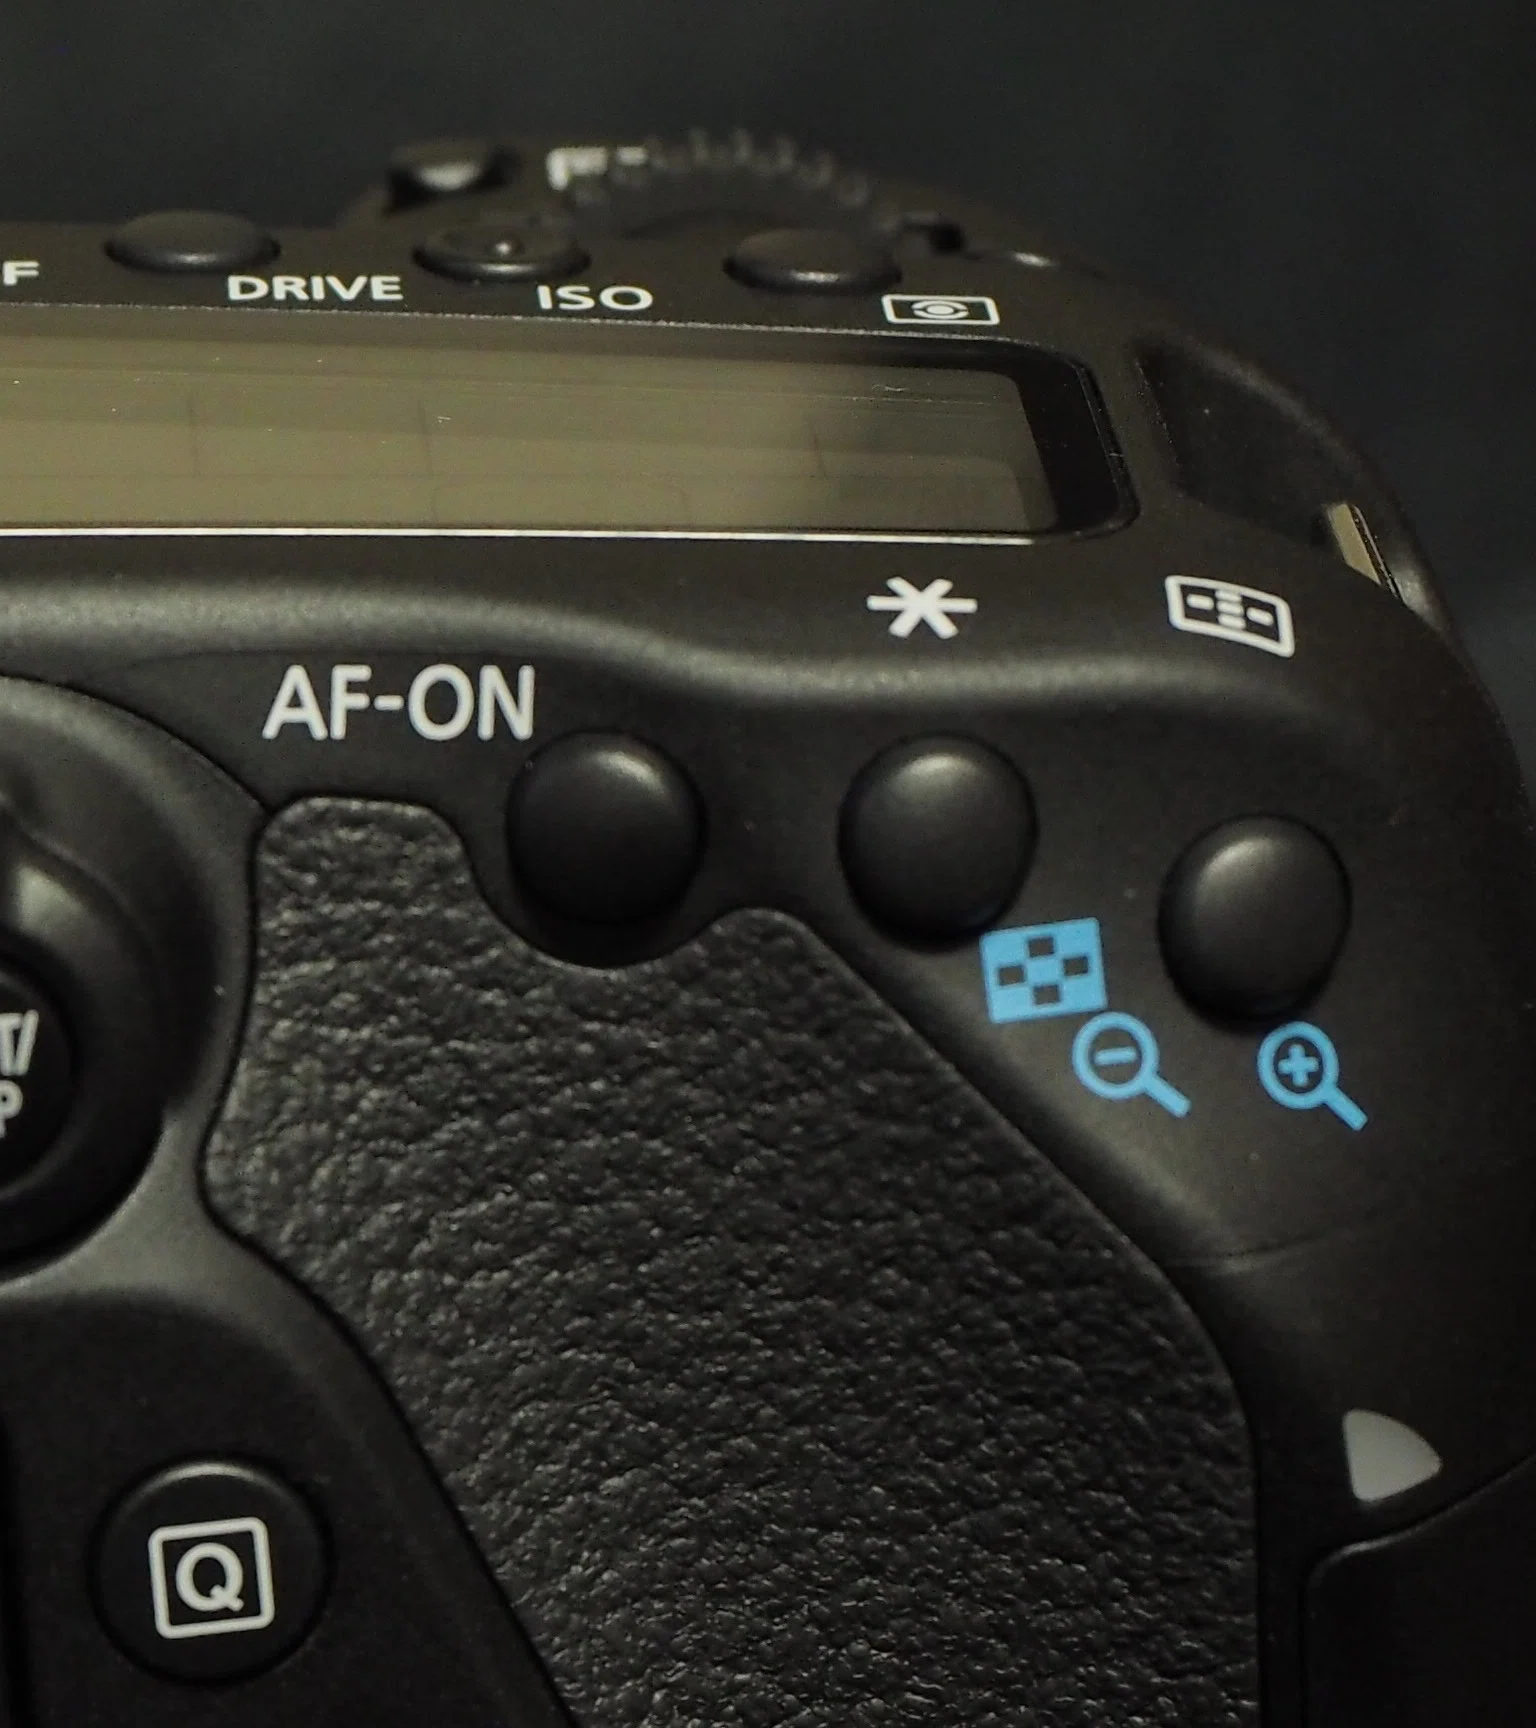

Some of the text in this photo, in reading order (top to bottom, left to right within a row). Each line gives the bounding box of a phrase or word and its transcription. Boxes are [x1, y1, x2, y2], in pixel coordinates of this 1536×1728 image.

[227, 274, 404, 304] DRIVE
[536, 283, 654, 311] ISO
[262, 662, 535, 741] AF-ON
[175, 1541, 245, 1612] Q
